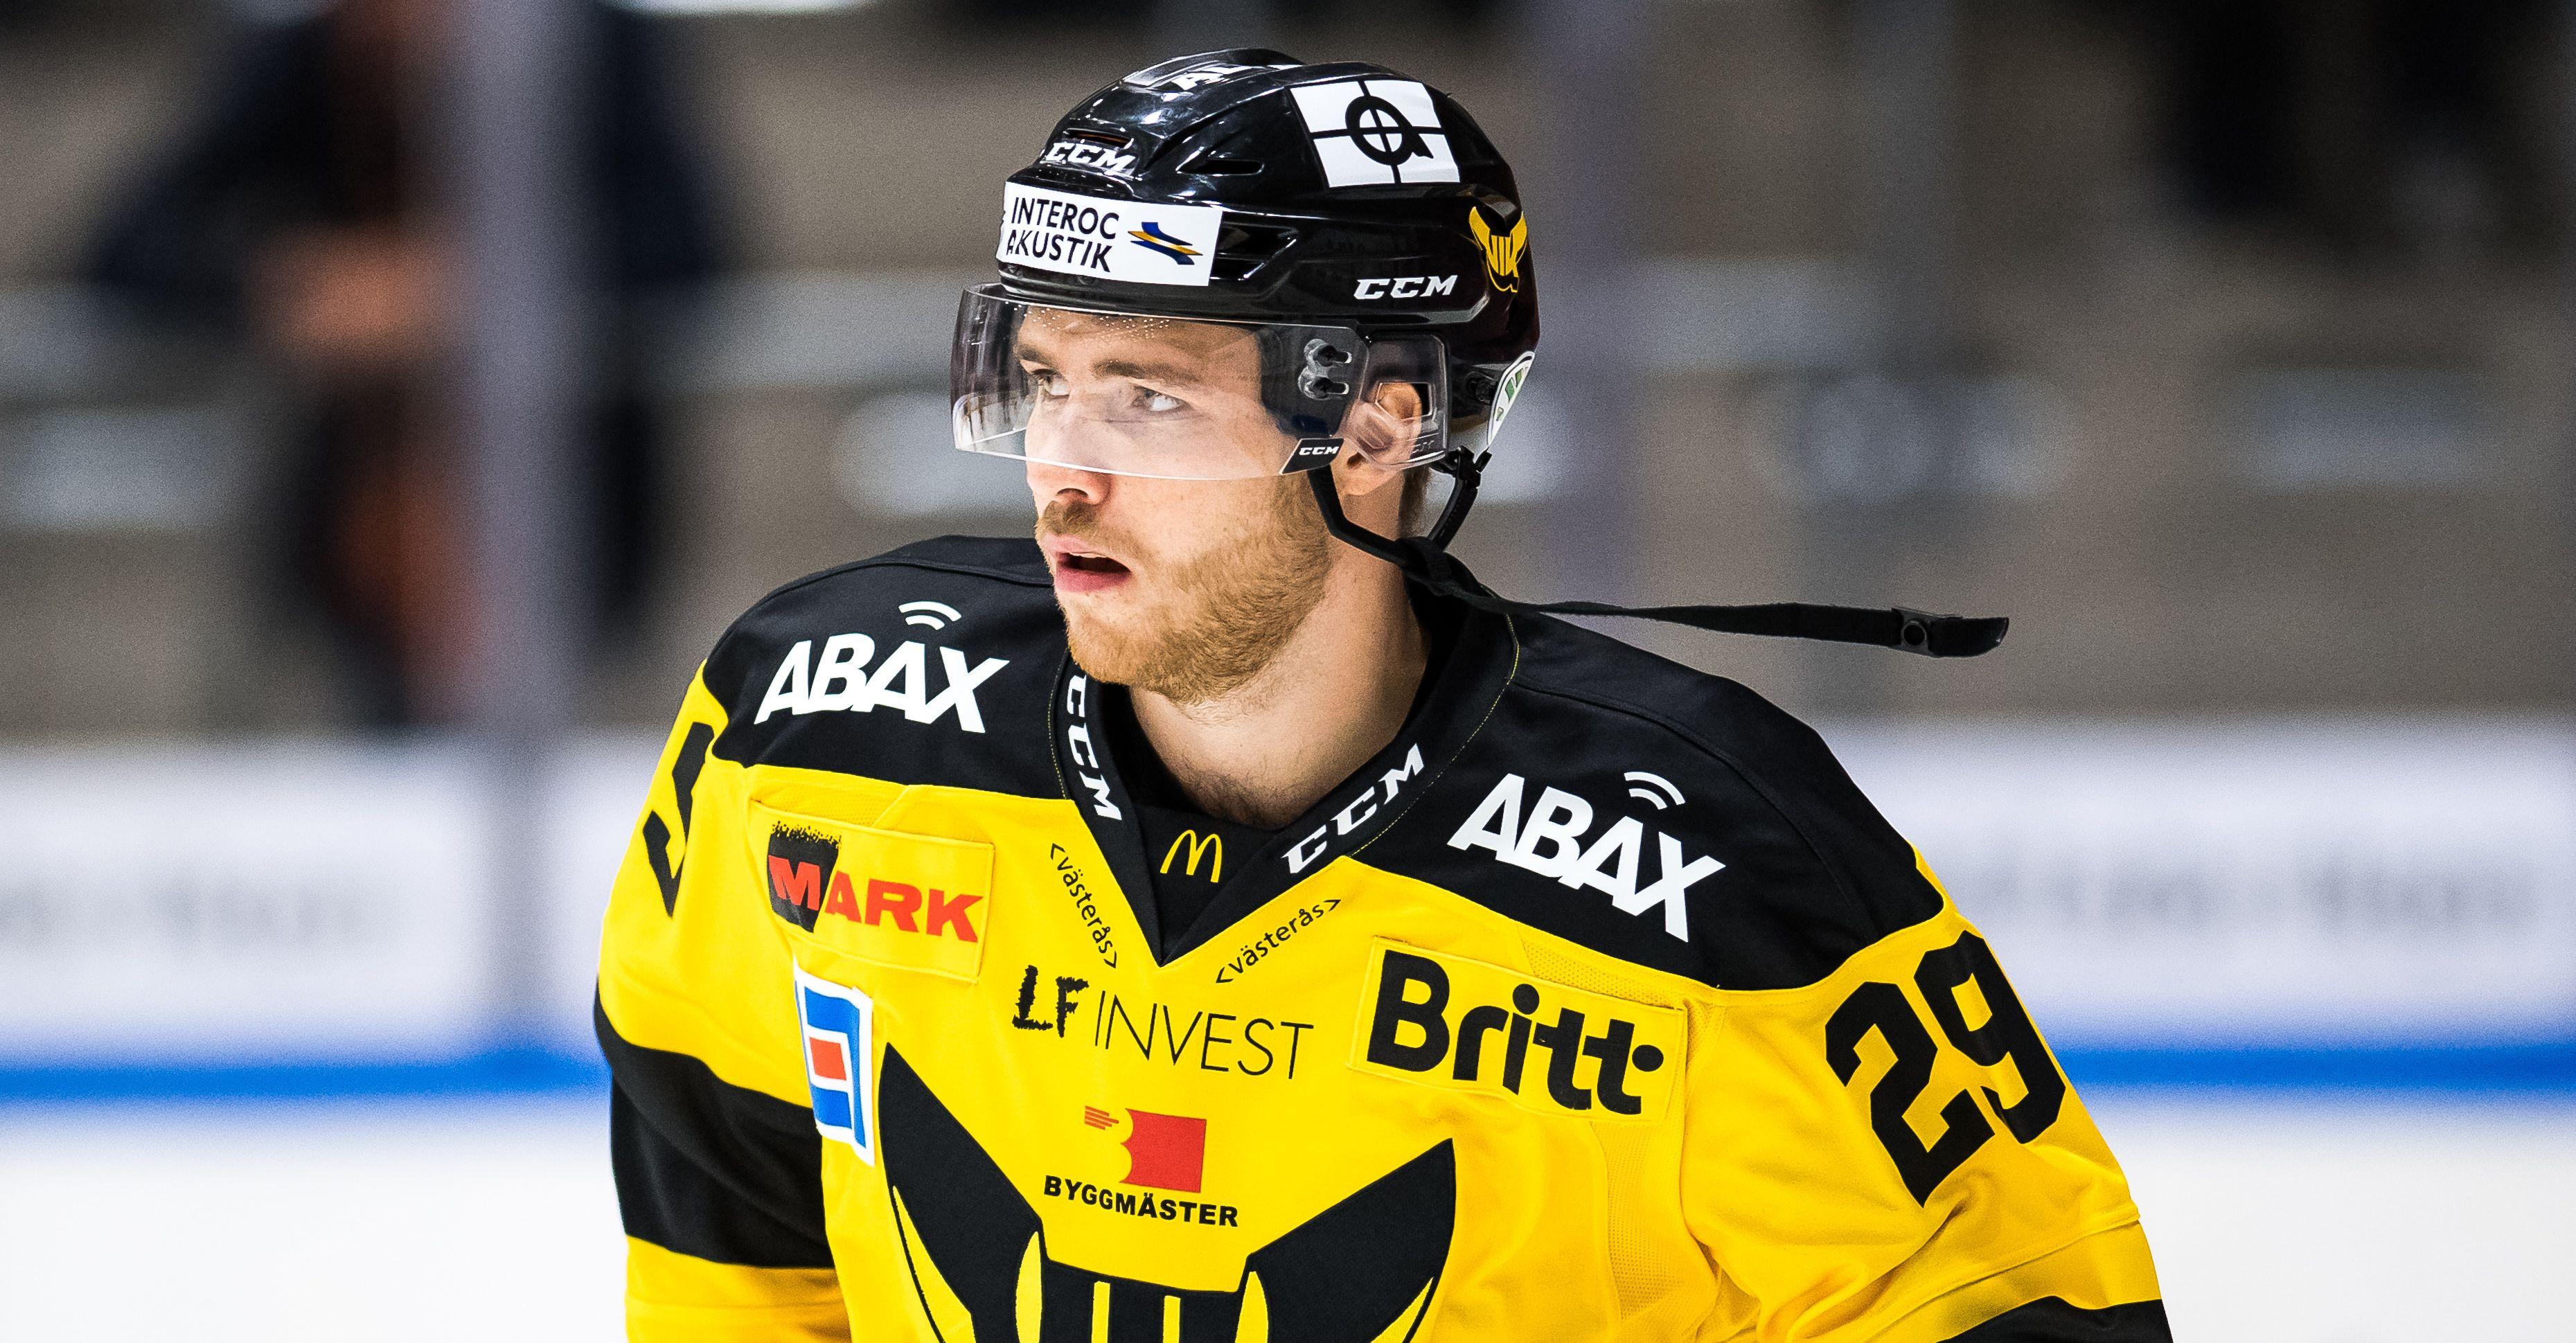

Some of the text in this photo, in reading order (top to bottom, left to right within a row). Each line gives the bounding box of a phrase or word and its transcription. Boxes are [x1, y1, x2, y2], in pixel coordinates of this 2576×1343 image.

[1041, 142, 1137, 174] CCM
[1006, 229, 1112, 273] AKUSTIK
[1011, 197, 1120, 240] INTEROC
[1353, 274, 1458, 300] CCM
[1298, 446, 1340, 456] CCM
[754, 633, 1010, 733] ABAX
[1067, 674, 1122, 821] CCM
[1281, 743, 1424, 874] CCM
[767, 855, 984, 943] MARK
[1446, 773, 1726, 943] ABAX
[1011, 965, 1314, 1080] LF INVEST
[1367, 949, 1664, 1115] Britt
[1824, 930, 2066, 1209] 29
[1043, 1175, 1238, 1227] BYGGMÄSTER
